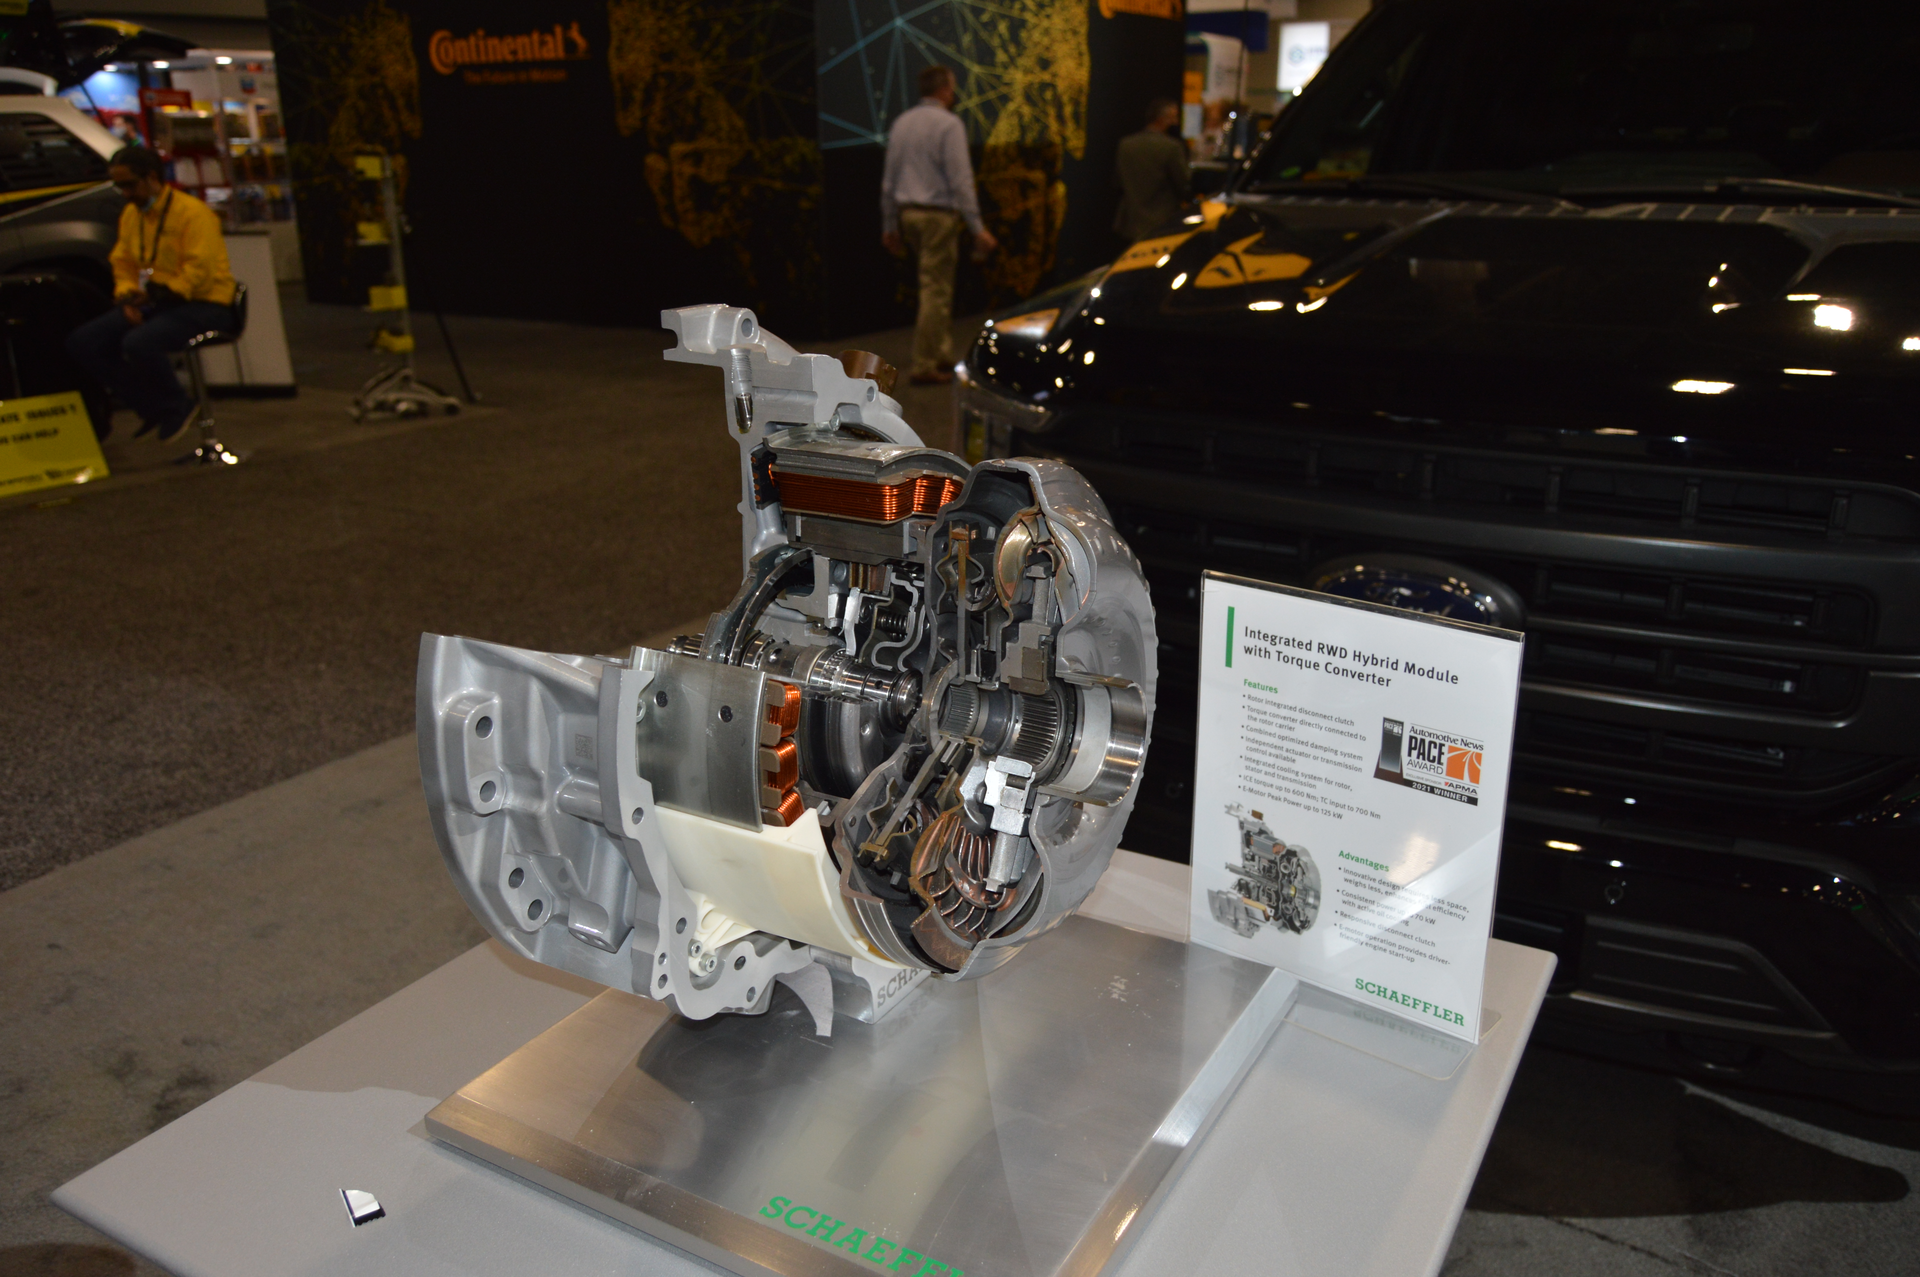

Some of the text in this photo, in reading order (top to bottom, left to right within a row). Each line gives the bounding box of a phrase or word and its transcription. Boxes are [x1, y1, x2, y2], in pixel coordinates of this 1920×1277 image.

[429, 23, 565, 75] Continental
[1244, 645, 1391, 687] with Torque Converter
[1245, 626, 1458, 684] Integrated RWD Hybrid Module
[1244, 679, 1278, 694] Features
[1247, 705, 1267, 716] Torque
[1269, 712, 1298, 723] converter
[1299, 719, 1323, 731] directly
[1325, 727, 1358, 739] connected
[1248, 694, 1354, 726] Rotor integrated disconnect clutch
[1275, 723, 1295, 731] carrier
[1410, 726, 1484, 751] Automotive News
[1246, 725, 1363, 761] Combined optimized damping system
[1246, 737, 1284, 751] Independent
[1285, 748, 1311, 758] actuator
[1321, 757, 1362, 772] transmission
[1246, 746, 1296, 763] control available
[1408, 735, 1445, 765] PACE
[1245, 756, 1275, 769] Integrated
[1277, 766, 1299, 777] cooling
[1301, 773, 1323, 782] system
[1335, 782, 1352, 791] rotor,
[1245, 765, 1262, 773] stator
[1277, 774, 1316, 789] transmission
[1407, 759, 1443, 775] AWARD
[1243, 786, 1266, 796] E-Motor
[1268, 793, 1281, 801] Peak
[1283, 797, 1302, 807] Power
[1254, 778, 1274, 788] torque
[1292, 789, 1304, 797] 600
[1306, 793, 1318, 802] Nm;
[1329, 800, 1346, 809] input
[1356, 807, 1368, 815] 700
[1370, 811, 1380, 819] Nm
[1413, 782, 1430, 792] 2021
[1434, 788, 1467, 802] WINNER
[1447, 782, 1477, 794] APMA
[1339, 850, 1389, 872] Advantages
[1342, 890, 1375, 905] Consistent
[1376, 902, 1396, 913] power
[1344, 868, 1376, 883] Innovative
[1378, 879, 1400, 890] design
[1431, 896, 1445, 905] less
[1447, 901, 1469, 913] space,
[1344, 878, 1366, 888] weighs
[1368, 884, 1383, 894] less,
[1433, 906, 1465, 921] efficiency
[1357, 904, 1375, 914] active
[1339, 924, 1450, 965] E-motor operation provides driver-
[1340, 911, 1435, 947] Responsive disconnect clutch
[1339, 932, 1415, 963] friendly engine start-up
[1356, 978, 1464, 1026] SCHAEFFLER
